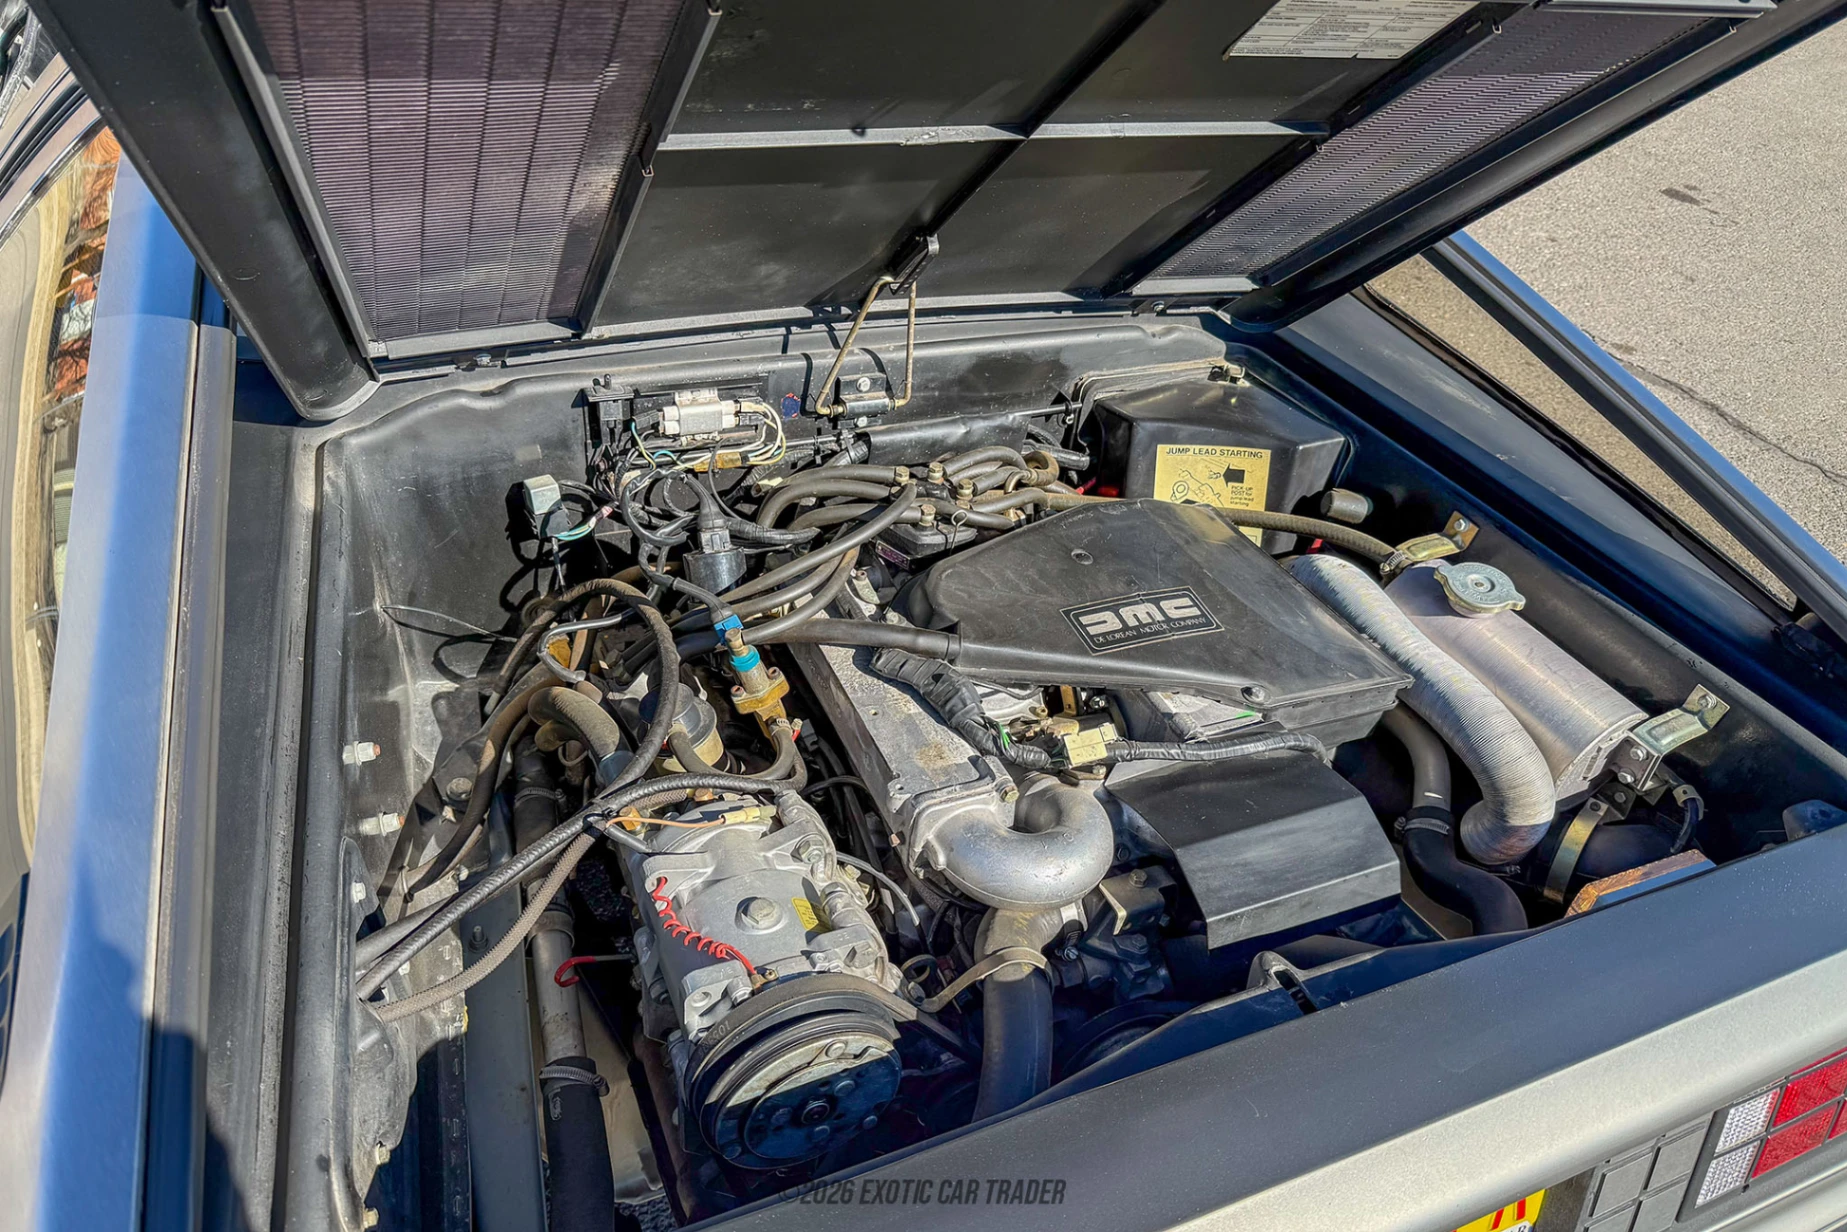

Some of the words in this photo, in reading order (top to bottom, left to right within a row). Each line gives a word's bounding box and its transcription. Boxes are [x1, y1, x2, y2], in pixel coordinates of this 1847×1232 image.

[1166, 447, 1191, 455] JUMP
[1192, 447, 1218, 456] LEAD
[1219, 449, 1263, 459] STARTING
[1105, 629, 1138, 641] LOREAN
[1139, 622, 1170, 635] MOTOR
[1170, 616, 1207, 628] COMPANY
